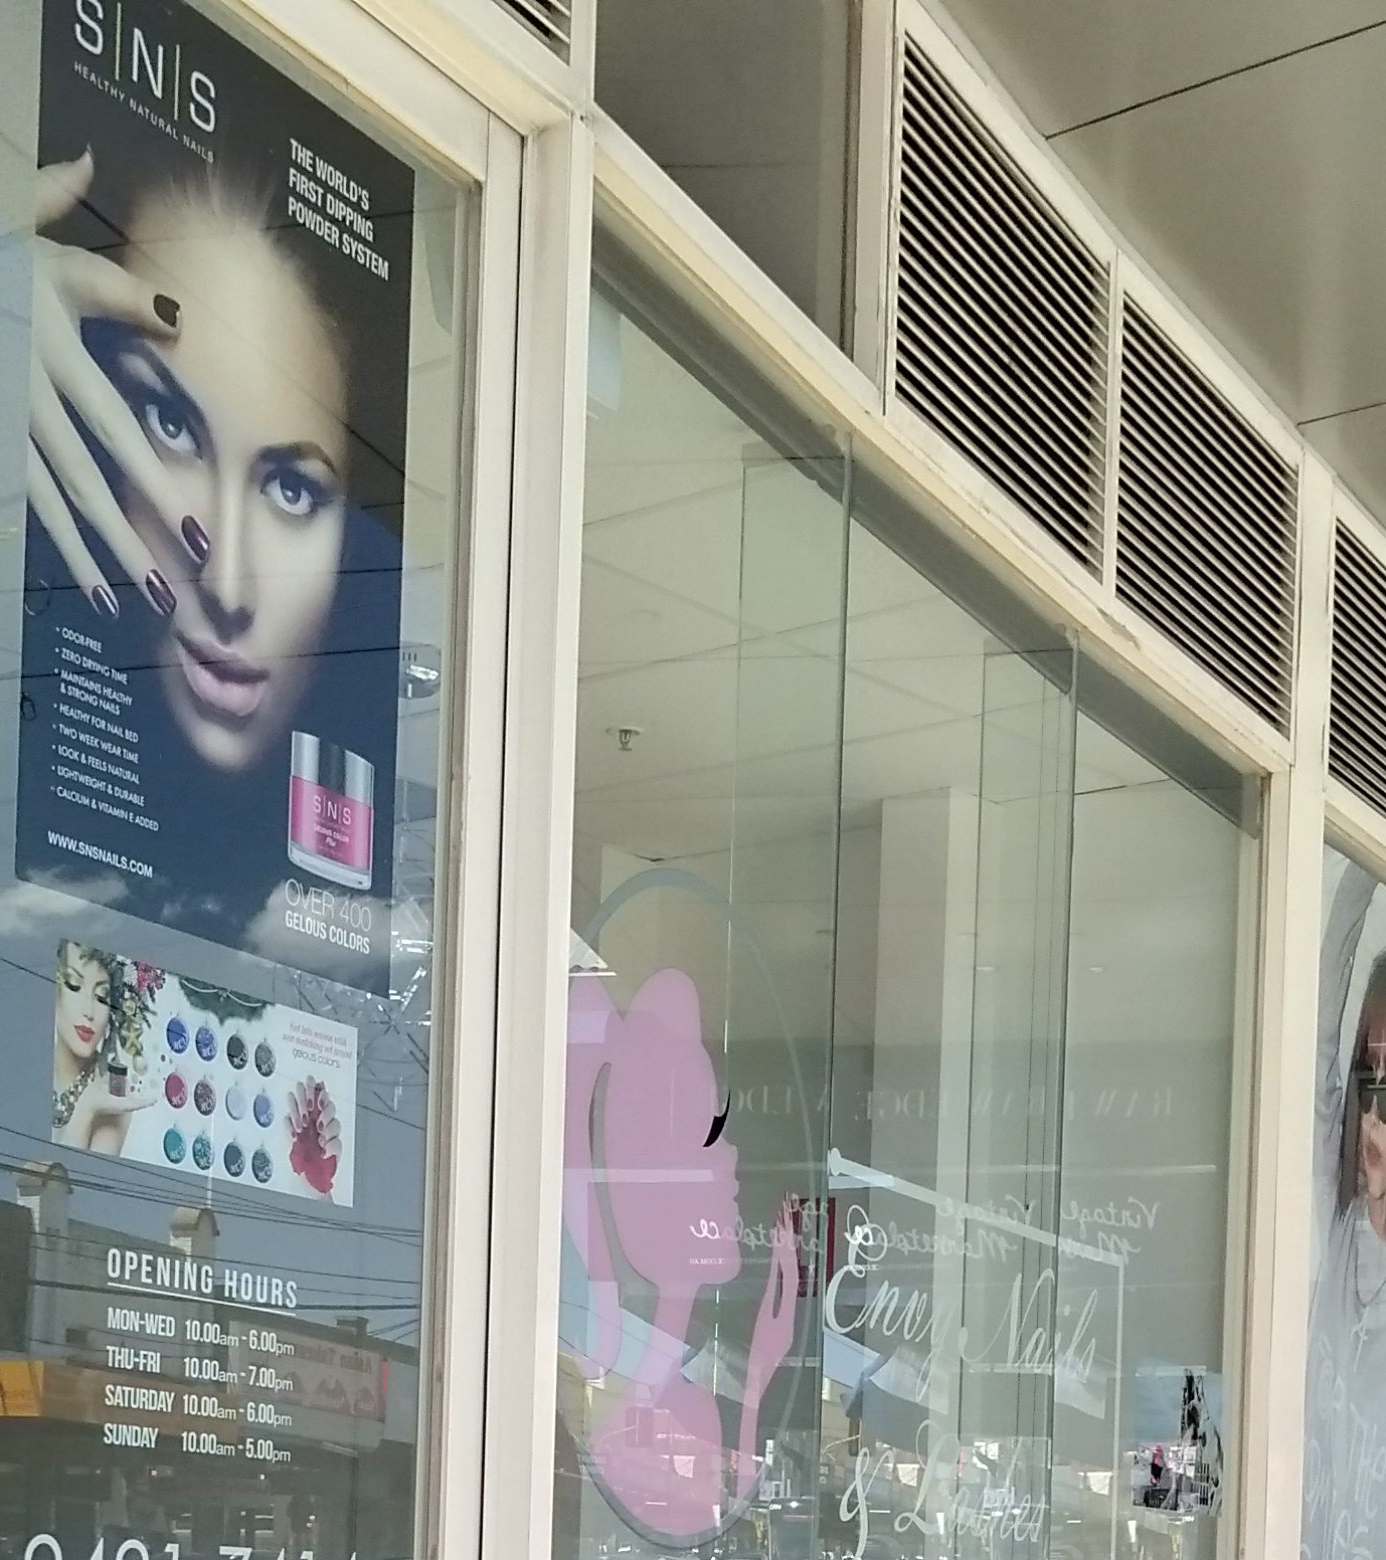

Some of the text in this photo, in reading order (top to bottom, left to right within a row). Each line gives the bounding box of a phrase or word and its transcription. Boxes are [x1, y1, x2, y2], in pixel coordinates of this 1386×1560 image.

[74, 61, 214, 163] HEALTHY NATURAL NAILS
[289, 138, 370, 211] THE WORLD'S
[288, 167, 374, 243] FIRST DIPPING
[288, 196, 389, 281] POWDER SYSTEM
[61, 647, 128, 685] ZERO DRYING TIME
[61, 669, 133, 706] MAINTAINS HEALTHY
[60, 682, 120, 716] & STRONG NAILS
[58, 723, 139, 764] TWO WEEK WEAR TIME
[59, 703, 139, 743] HEALTHY FOR NAIL BED
[57, 765, 145, 807] LIGHTWEIGHT & DURABLE
[58, 744, 140, 785] LOOK & FEELS NATURAL
[56, 786, 159, 832] CALCIUM & VITAMIN E ADDED
[47, 830, 153, 879] WWW.SNSNAILS.COM
[285, 878, 371, 932] OVER 400
[285, 910, 370, 955] GELOUS COLORS
[107, 1248, 298, 1309] OPENING HOURS
[825, 1204, 1098, 1403] Envy Nails
[107, 1307, 295, 1357] MON-WED 10.00am 6.00pm
[106, 1345, 294, 1393] THU-FRI 10.00am 7.00pm
[105, 1384, 292, 1427] SATURDAY 10.00am 6.00pm
[103, 1423, 291, 1463] SUNDAY 10.00am 5.00pm
